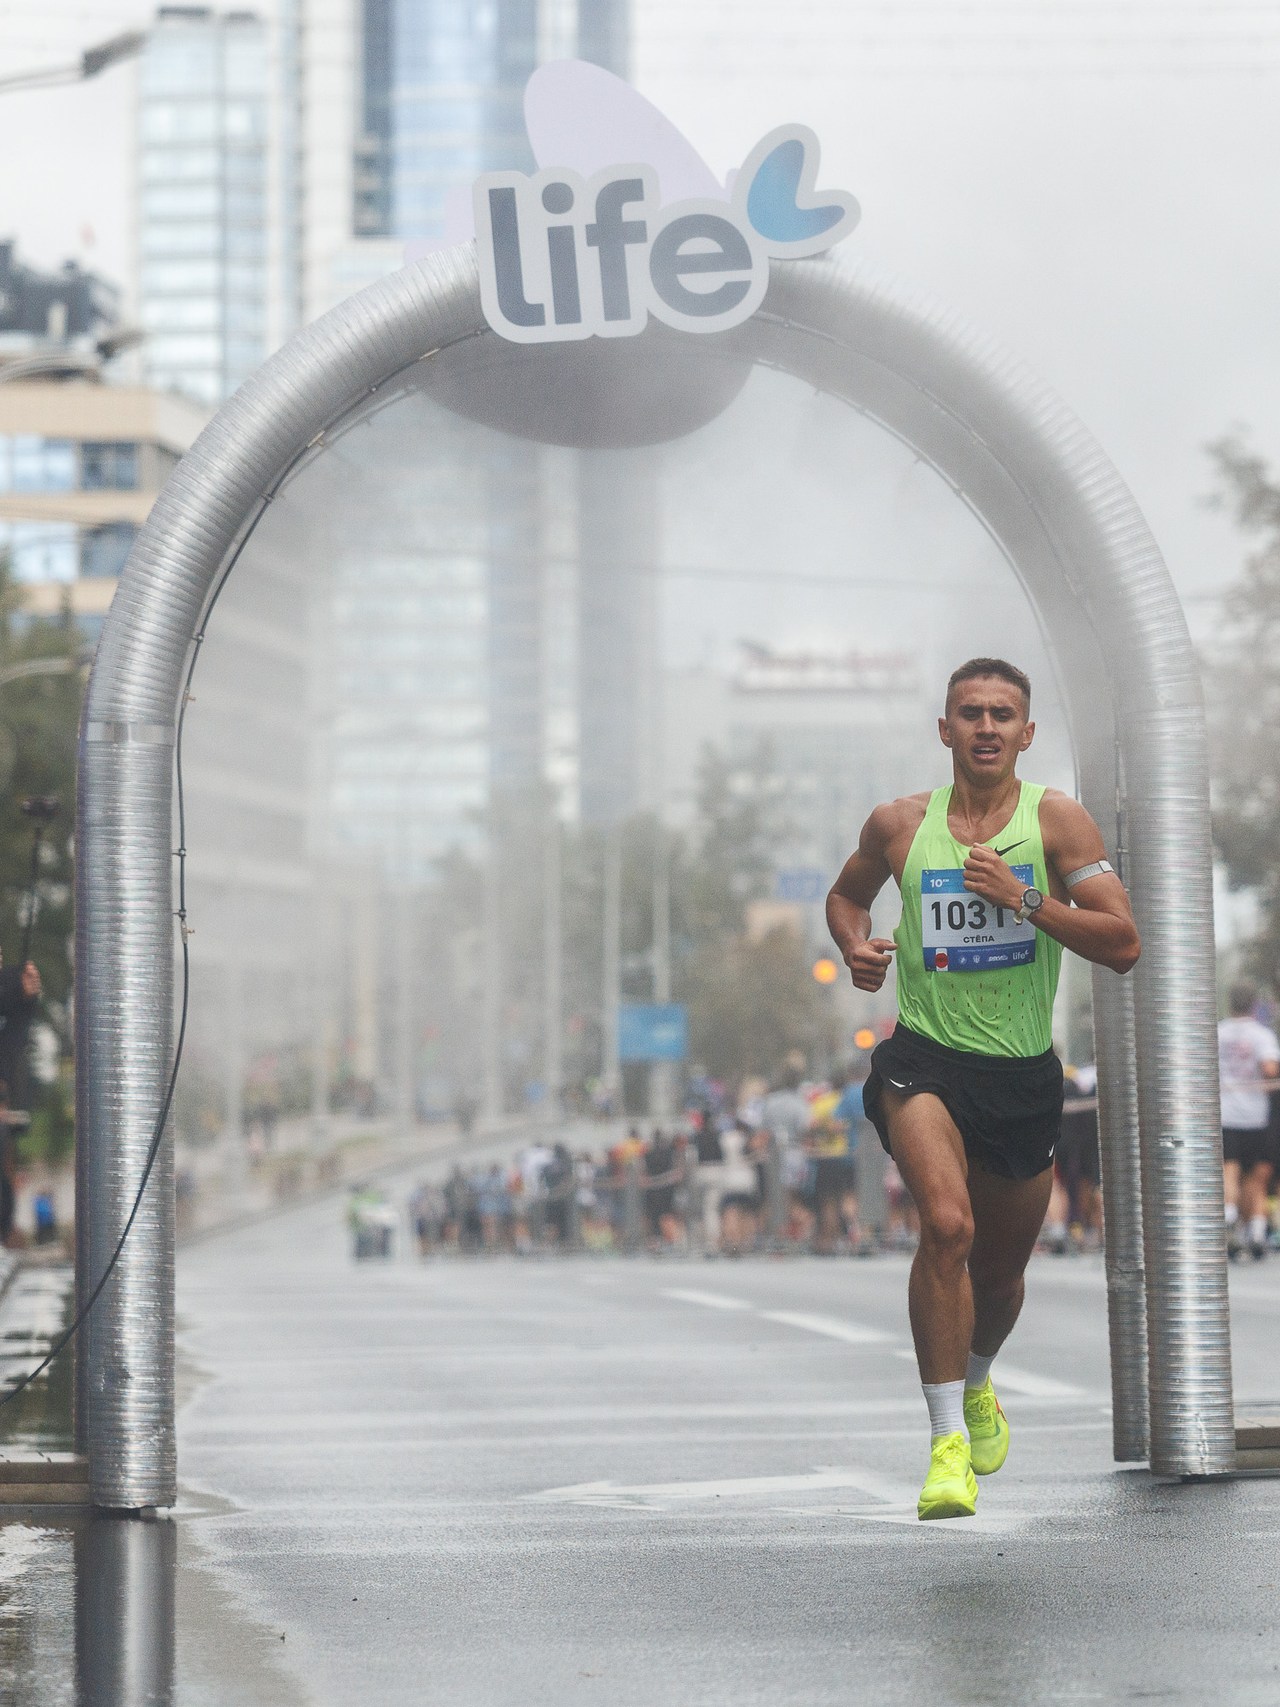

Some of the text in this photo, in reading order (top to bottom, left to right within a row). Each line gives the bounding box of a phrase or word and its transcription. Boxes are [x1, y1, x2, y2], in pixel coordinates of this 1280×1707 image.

[488, 177, 753, 327] life
[931, 900, 1023, 931] 1031
[963, 935, 995, 943] СТЁПА
